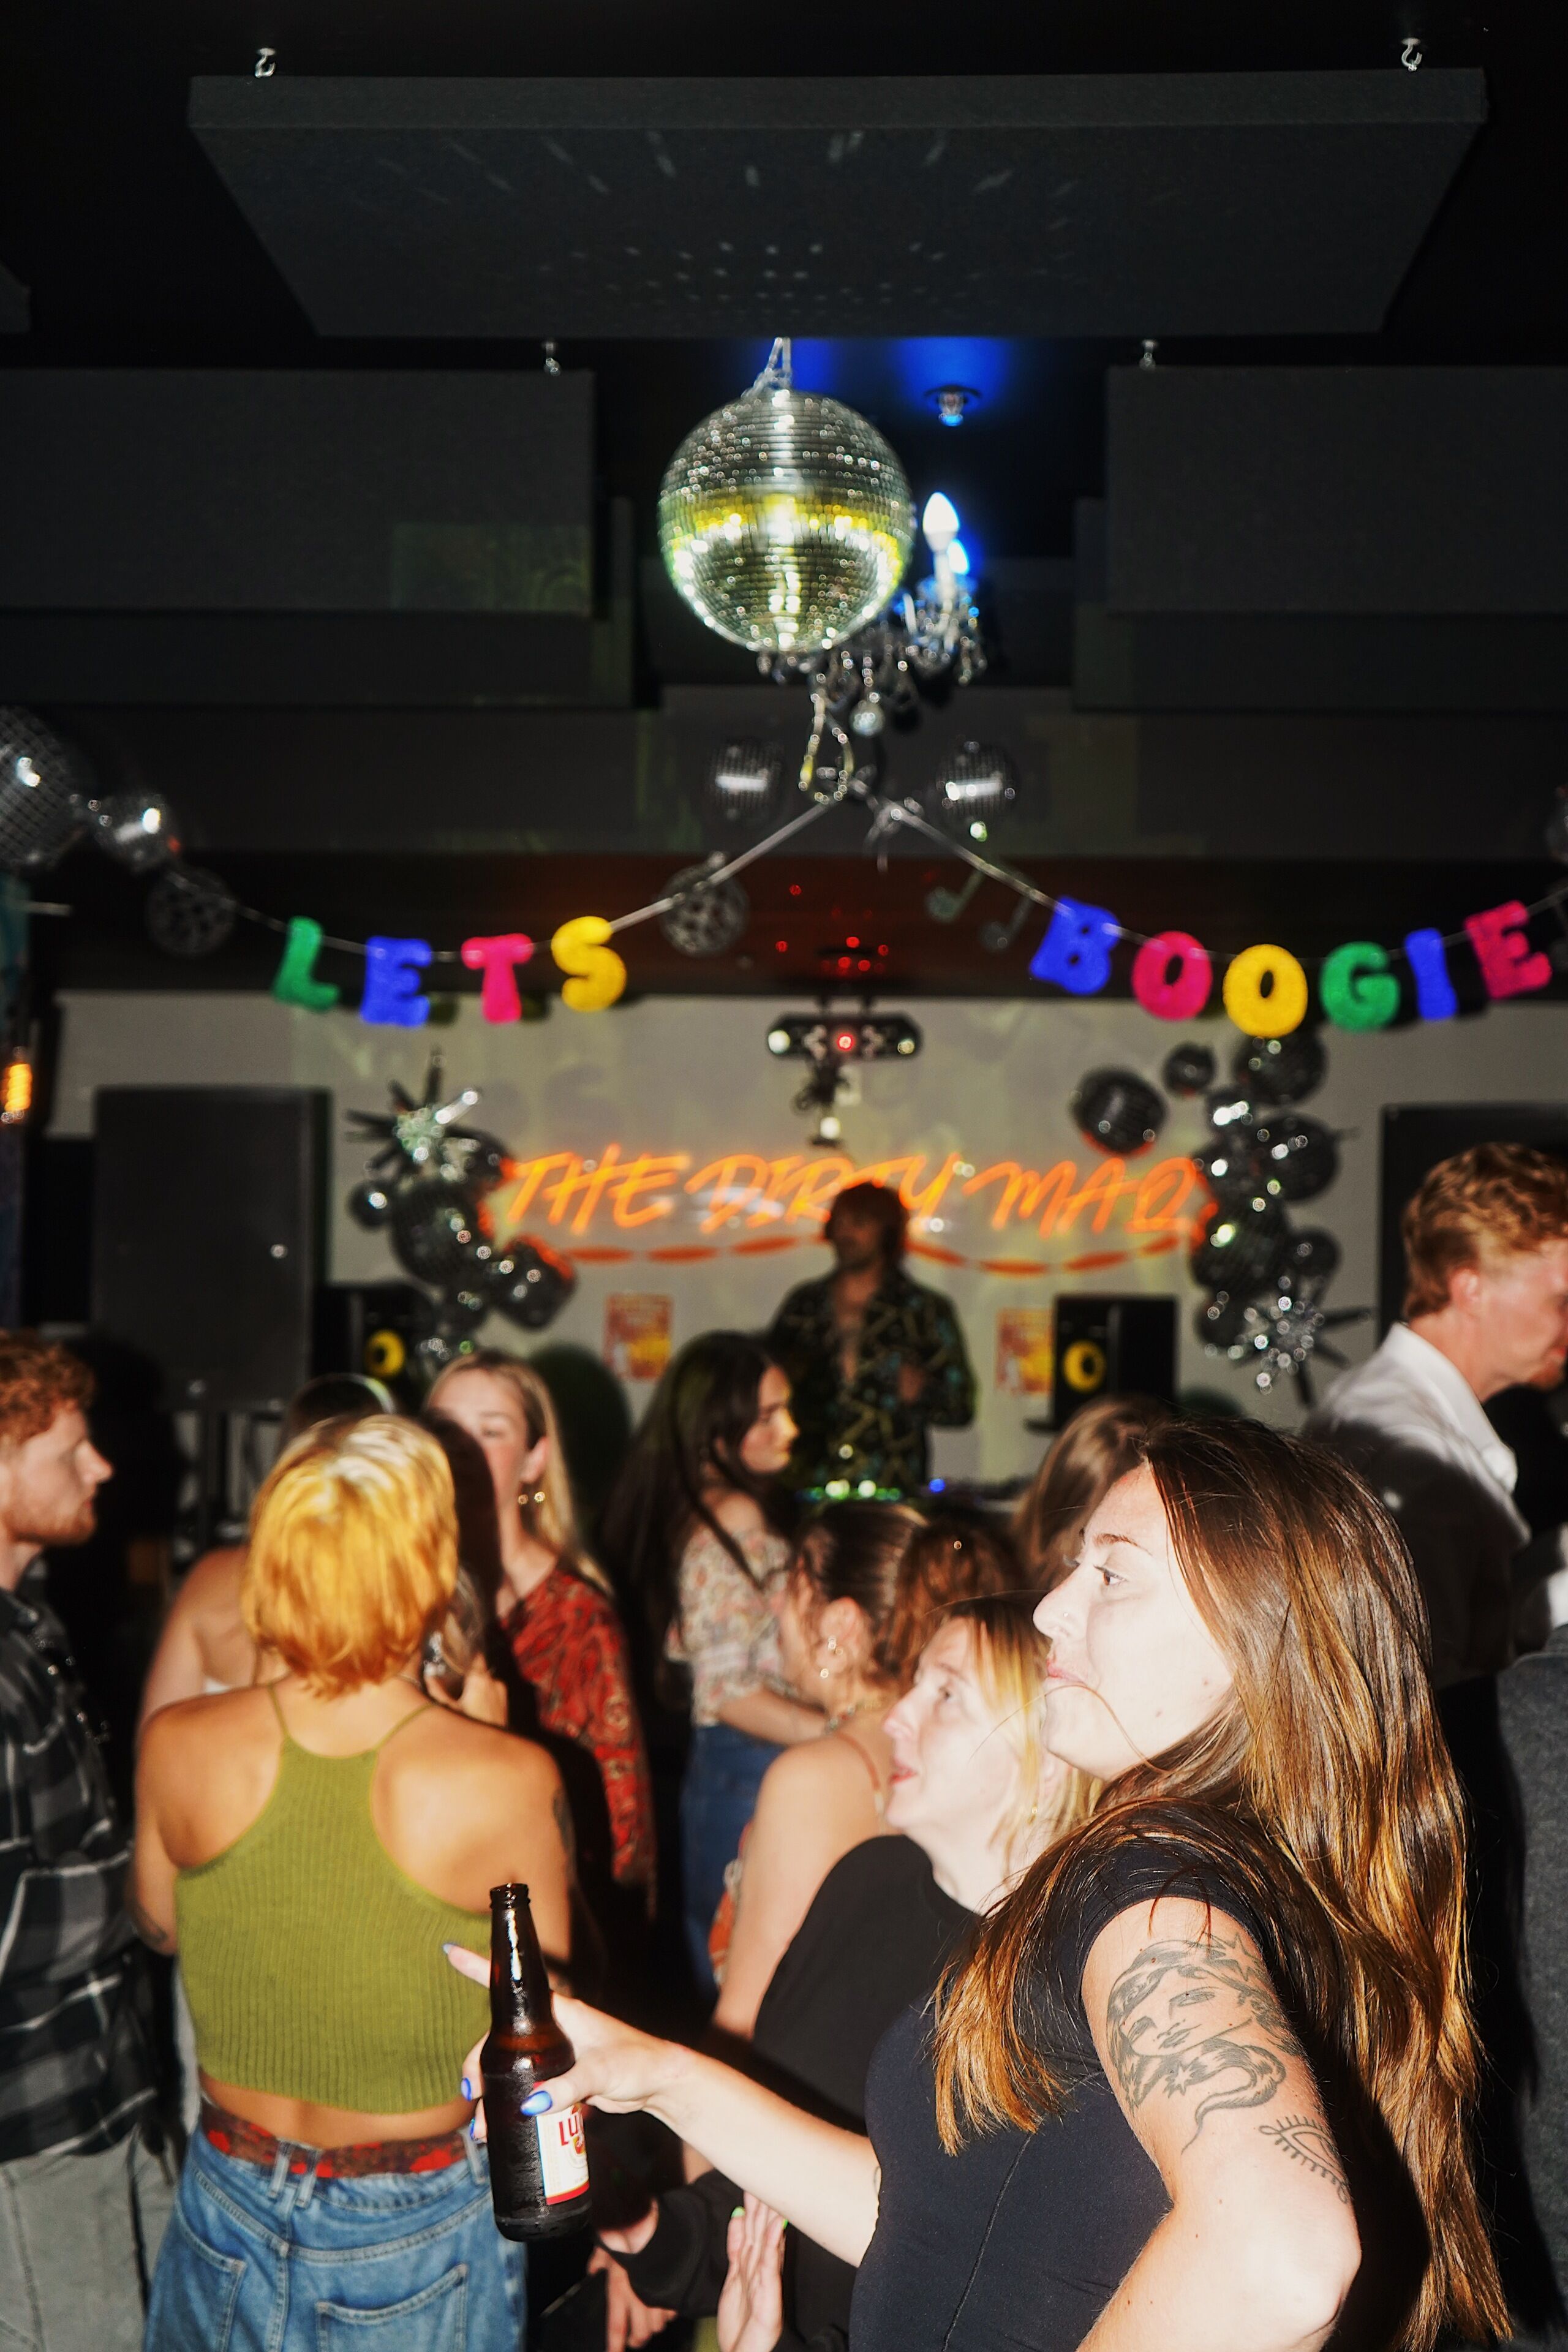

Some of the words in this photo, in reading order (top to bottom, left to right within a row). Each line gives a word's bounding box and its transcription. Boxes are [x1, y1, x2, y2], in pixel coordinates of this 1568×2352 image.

[272, 915, 628, 1029] LETS
[1030, 895, 1553, 1039] BOOGIE
[508, 1144, 691, 1236] THE
[684, 1152, 961, 1236] DIRTY
[559, 2113, 584, 2146] LU
